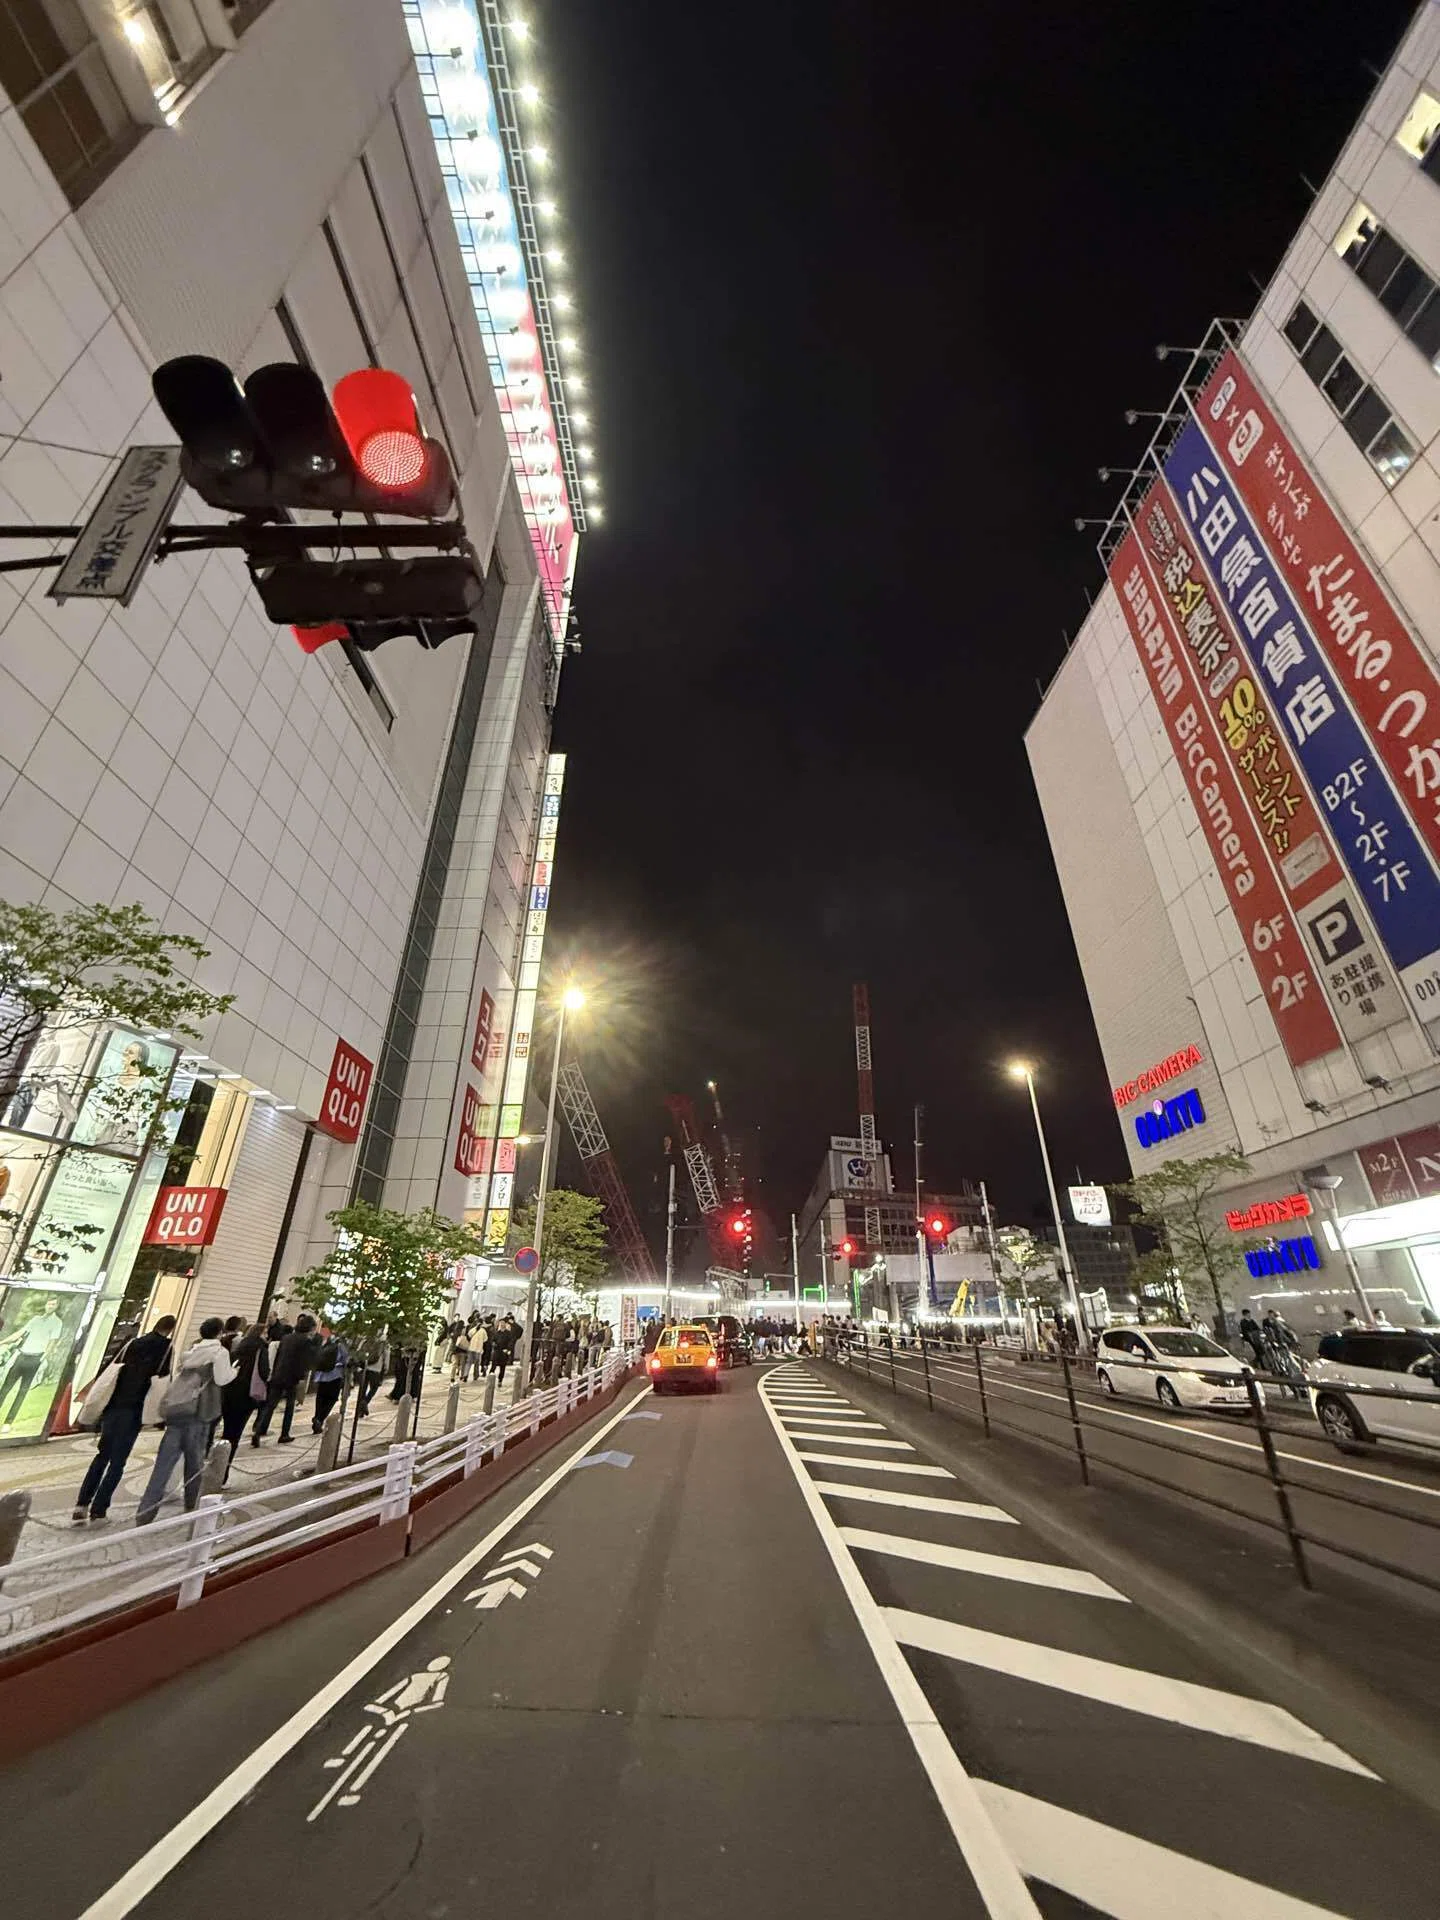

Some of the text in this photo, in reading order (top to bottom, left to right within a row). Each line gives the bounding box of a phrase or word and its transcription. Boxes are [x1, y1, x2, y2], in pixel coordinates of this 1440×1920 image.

[1265, 442, 1312, 520] ポイントが
[1267, 502, 1302, 566] ダブルで
[1123, 564, 1184, 705] ビックカメラ
[1163, 545, 1230, 678] 税込表示
[1187, 464, 1337, 745] 小田急百貨店
[1219, 677, 1265, 740] 10%
[1306, 553, 1440, 828] たまる・つか
[1175, 703, 1256, 897] BicCamera
[1254, 724, 1302, 817] ポイント
[1321, 758, 1370, 812] B2F
[1355, 821, 1391, 863] 2F
[1373, 860, 1412, 903] 7F
[1252, 914, 1285, 951] 6F
[1272, 971, 1309, 1011] 2F
[1315, 911, 1348, 958] P
[1330, 973, 1351, 1006] あり
[1344, 963, 1377, 1017] 駐車場
[336, 1053, 366, 1096] UNI
[1114, 1043, 1204, 1109] BIC CAMERA
[328, 1087, 361, 1129] QLO
[460, 1132, 483, 1171] QLO
[158, 1216, 203, 1240] QLO
[165, 1193, 207, 1213] UNI
